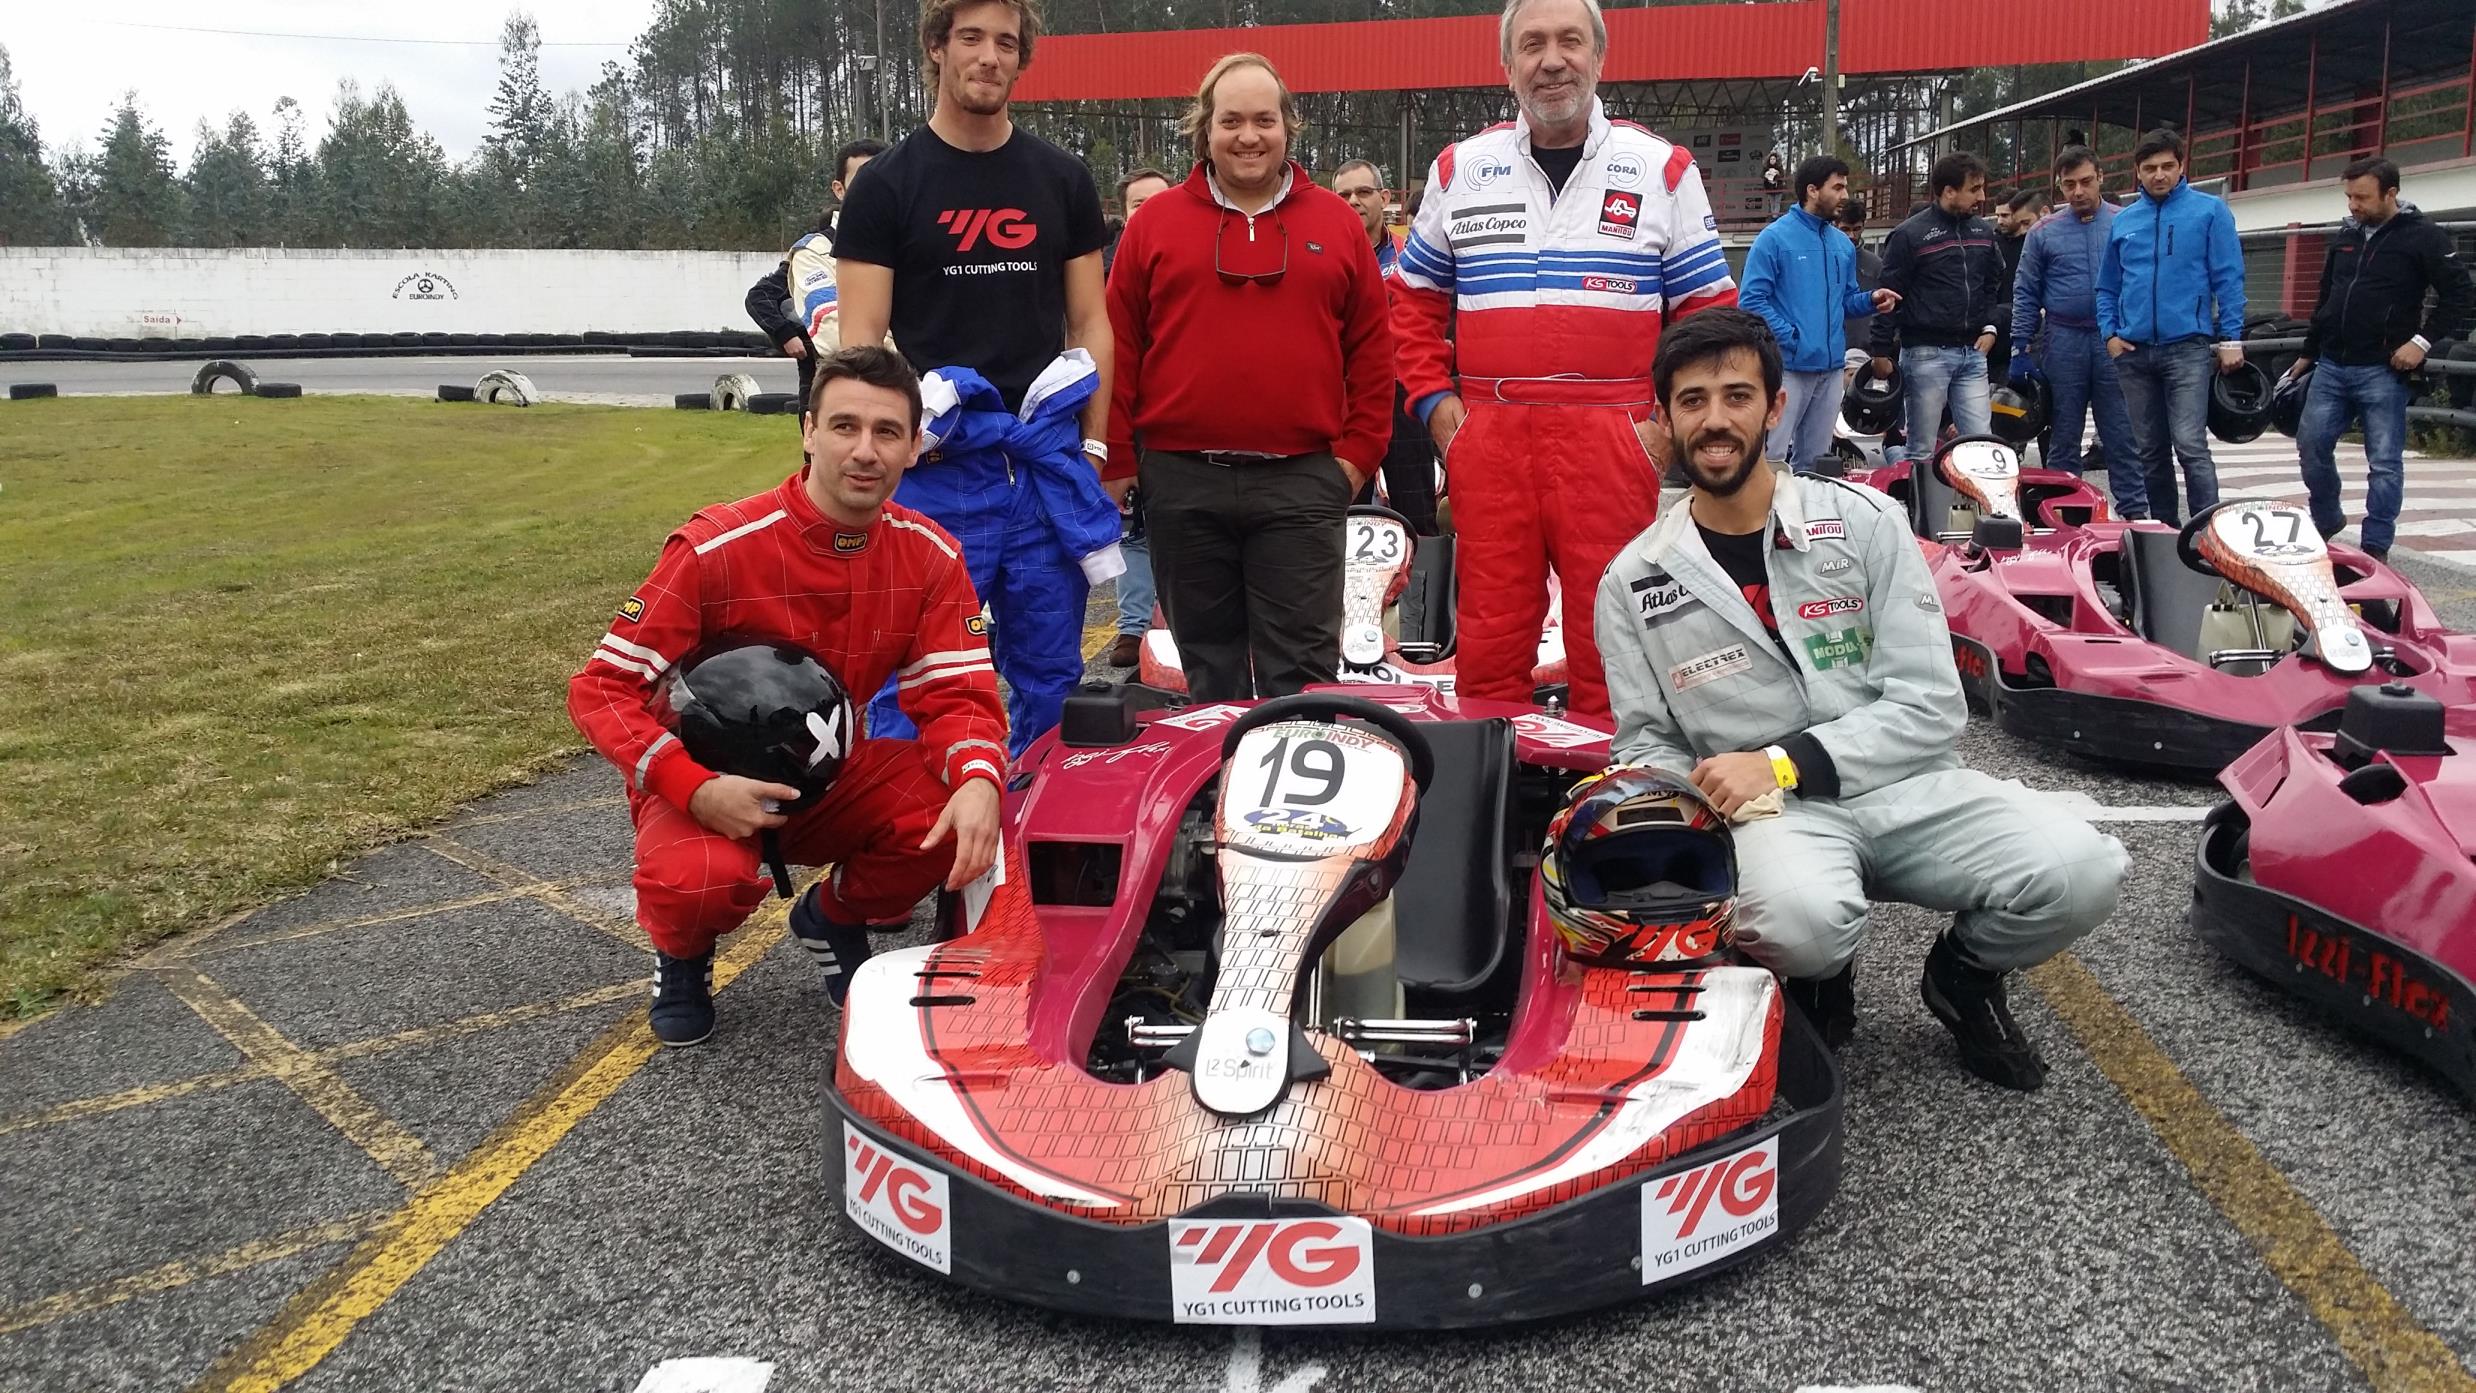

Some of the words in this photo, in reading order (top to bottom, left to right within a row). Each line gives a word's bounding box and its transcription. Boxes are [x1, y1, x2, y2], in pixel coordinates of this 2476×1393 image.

[1481, 165, 1511, 177] FM
[1606, 163, 1638, 176] CORA
[1449, 220, 1485, 236] Atlas
[1485, 217, 1526, 232] Copco
[942, 265, 963, 276] YG1
[964, 262, 1006, 275] CUTTING
[1006, 261, 1038, 272] TOOLS
[392, 272, 420, 299] ESCOLA
[424, 271, 459, 300] KARTING
[1585, 279, 1605, 288] KS
[1605, 279, 1634, 291] TOOLS
[1992, 448, 2007, 470] 9
[1806, 523, 1842, 536] ANITOU
[2241, 510, 2302, 548] 27
[837, 536, 865, 548] OMP
[1355, 525, 1399, 558] 23
[1640, 588, 1678, 613] Atlas
[1804, 605, 1827, 618] KS
[1827, 598, 1858, 612] TOOLS
[1259, 736, 1345, 807] 19
[862, 1211, 904, 1246] CUTTING
[903, 1235, 943, 1265] TOOLS
[1655, 1248, 1680, 1268] YG1
[1684, 1227, 1738, 1258] CUTTING
[1739, 1213, 1776, 1238] TOOLS
[1183, 1301, 1215, 1316] YG1
[1222, 1296, 1301, 1315] CUTTING
[1304, 1292, 1365, 1311] TOOLS
